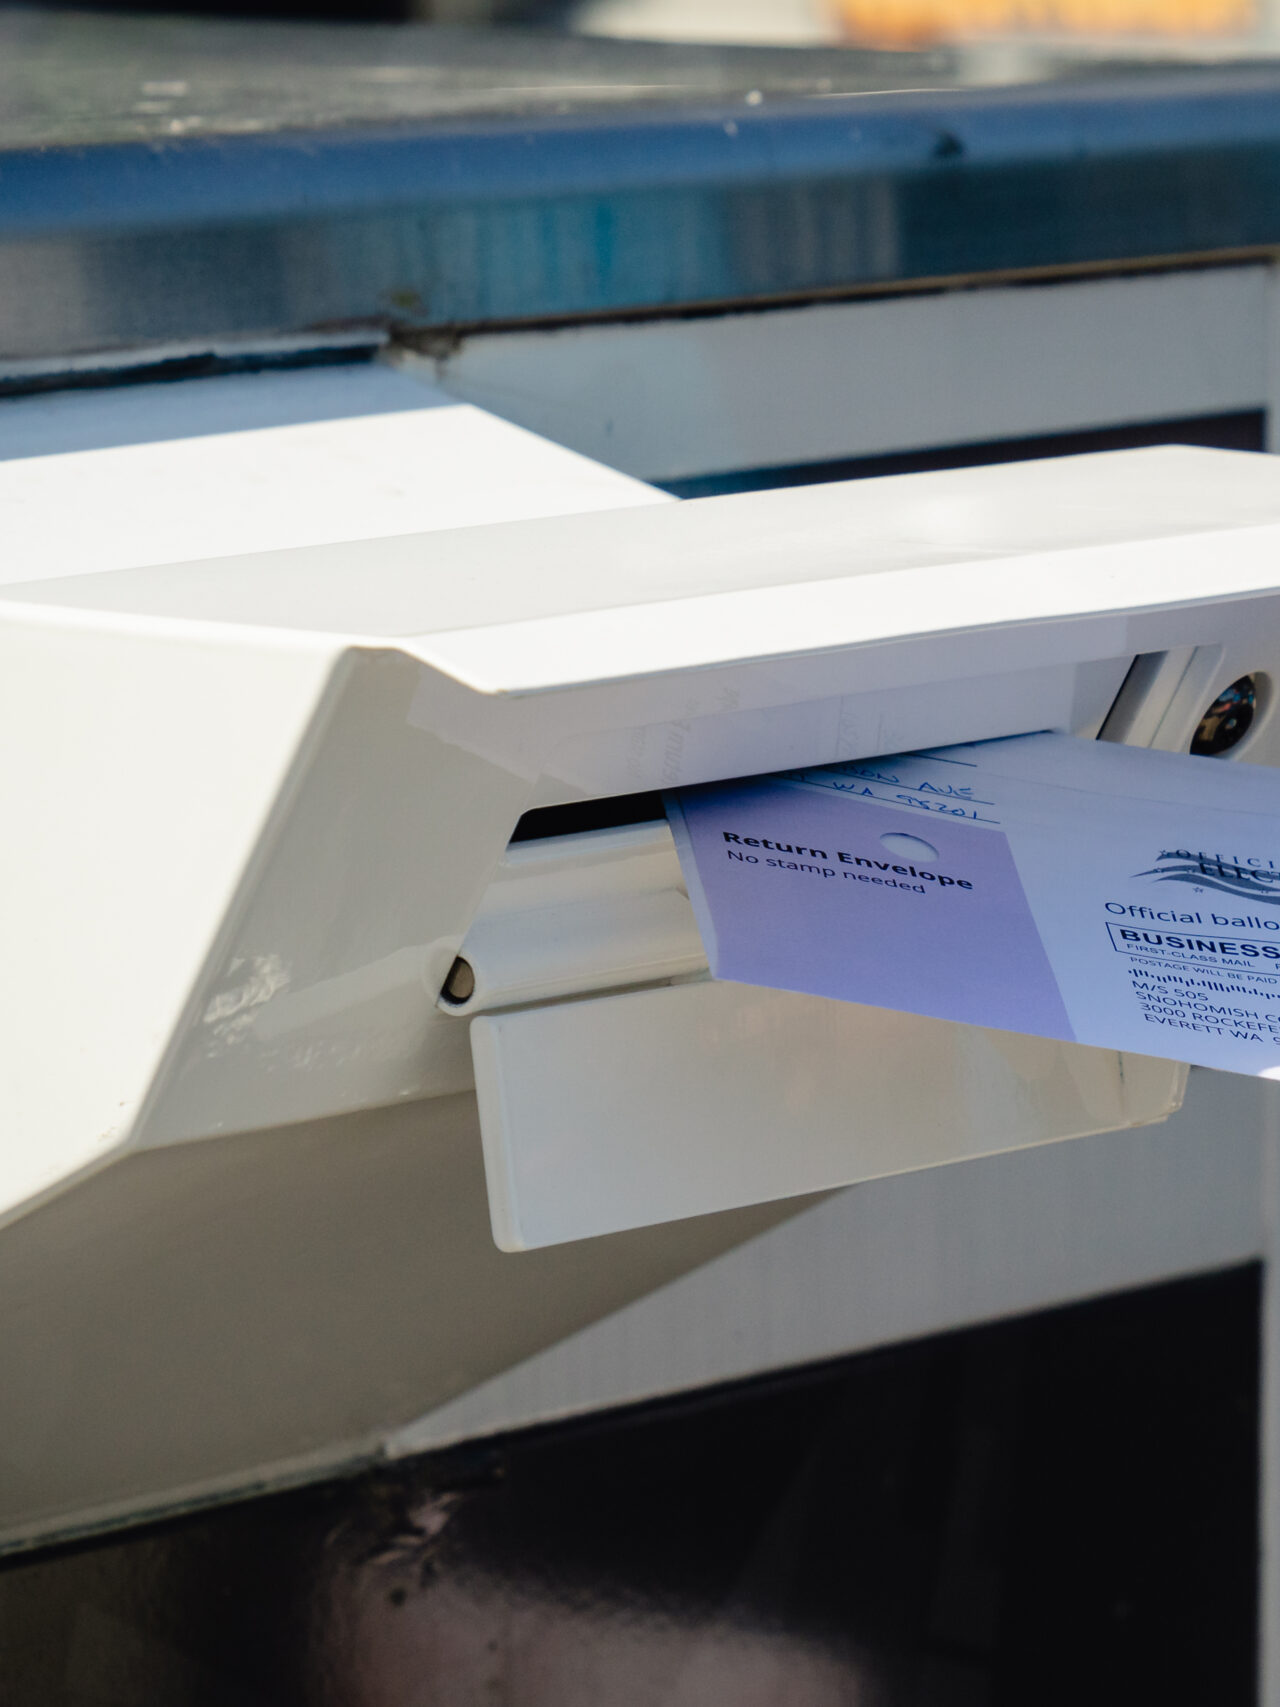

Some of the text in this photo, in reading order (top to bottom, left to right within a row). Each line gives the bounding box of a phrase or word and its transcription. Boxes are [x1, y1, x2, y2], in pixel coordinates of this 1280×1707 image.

[832, 781, 874, 796] WA
[917, 781, 975, 801] AVE
[722, 831, 973, 890] Return Envelope
[727, 850, 926, 894] No stamp needed
[1105, 902, 1202, 924] Official
[1120, 929, 1280, 959] BUSINESS
[1127, 944, 1218, 963] FIRST-CLASS
[1222, 958, 1256, 968] MAIL
[1130, 956, 1190, 972] POSTAGE
[1193, 967, 1225, 978] WILL
[1227, 972, 1244, 980] BE
[1247, 975, 1278, 985] PAID
[1132, 980, 1209, 1001] M/S 505
[1135, 991, 1259, 1020] SNOHOMISH
[1140, 1002, 1186, 1018] 3000
[1144, 1013, 1224, 1036] EVERETT
[1230, 1029, 1264, 1043] WA
